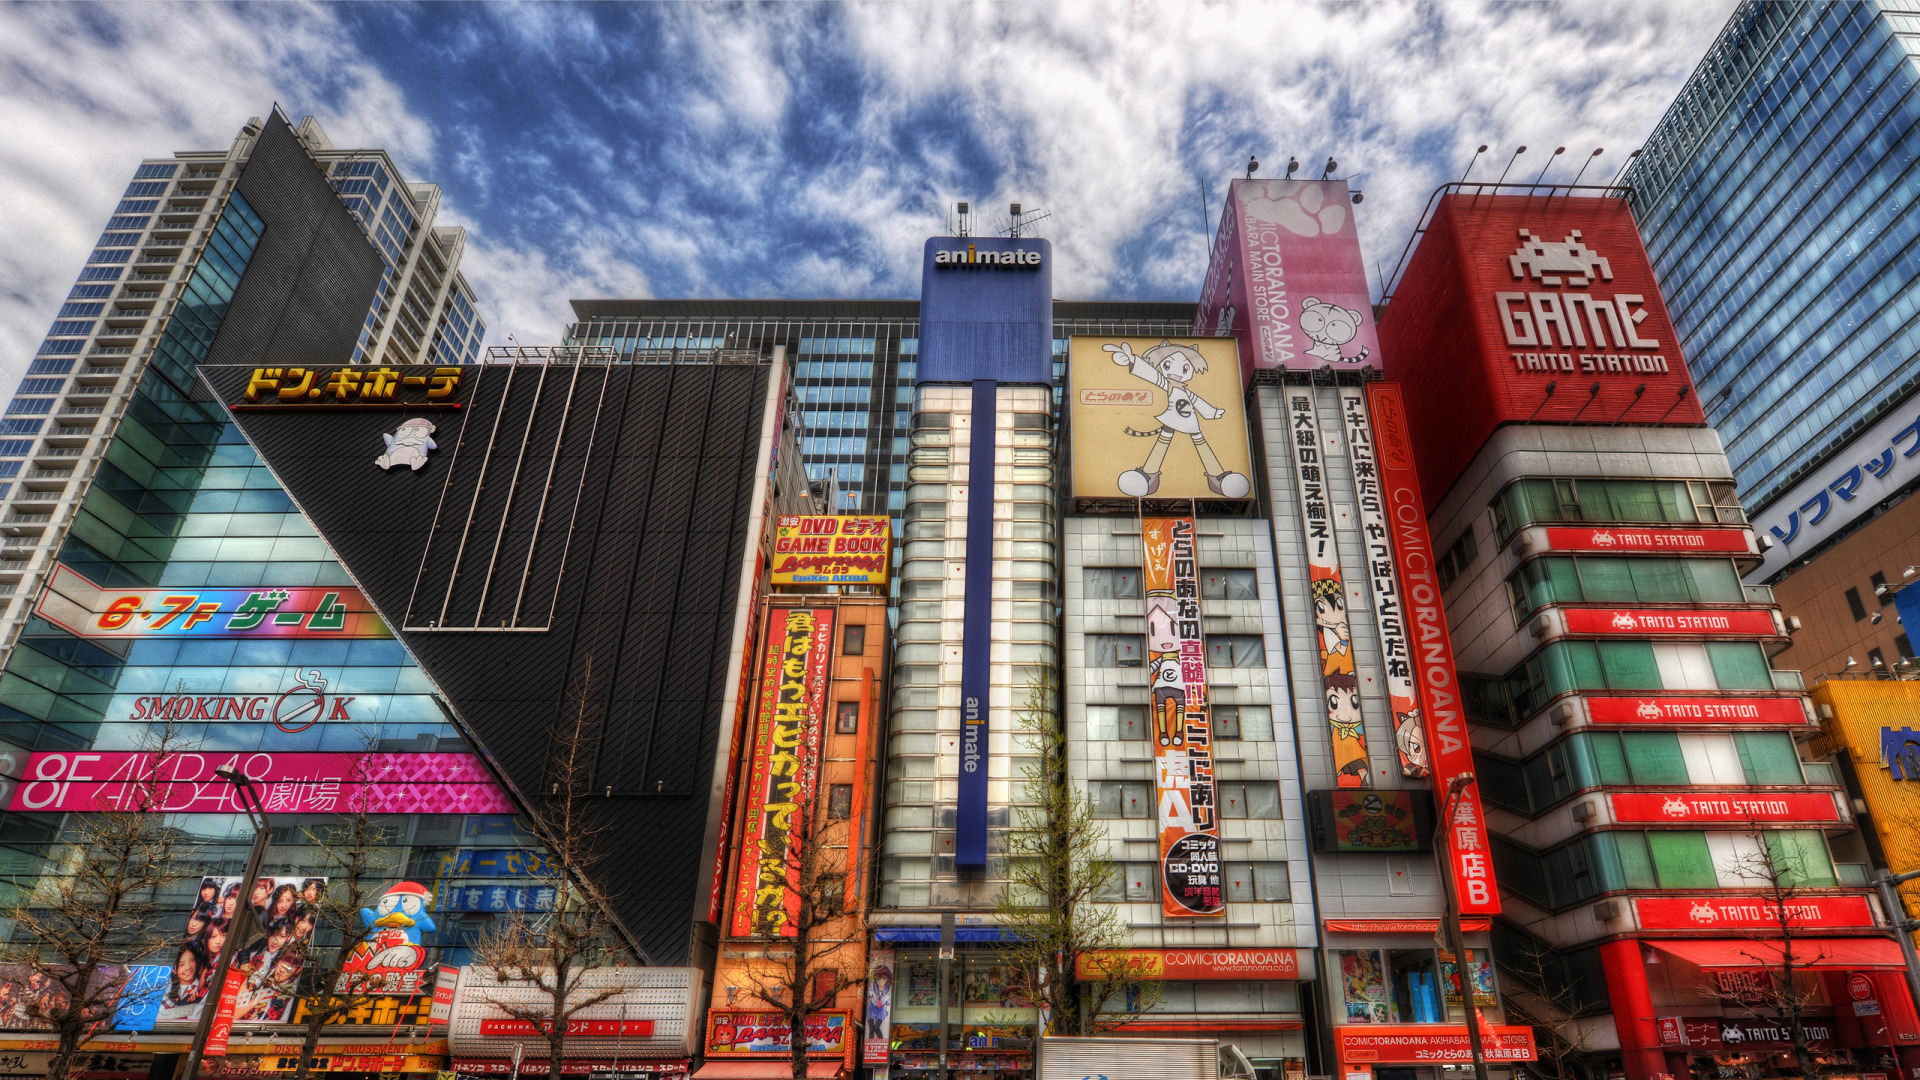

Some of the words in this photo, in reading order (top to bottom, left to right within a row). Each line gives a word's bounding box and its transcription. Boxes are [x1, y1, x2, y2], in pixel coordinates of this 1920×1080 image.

[935, 244, 1042, 265] animate
[1250, 251, 1265, 282] MAIN
[1259, 221, 1296, 363] ICTORANOANA
[1254, 285, 1270, 321] STORE
[1495, 291, 1661, 350] GAME
[1511, 352, 1575, 373] TAITO
[1578, 353, 1670, 375] STATION
[1084, 391, 1148, 402] とらのあな
[798, 517, 839, 536] DVD
[841, 517, 888, 536] ビデオ
[776, 537, 831, 554] GAME
[834, 537, 887, 554] BOOK
[1616, 534, 1653, 546] TAITO
[1654, 534, 1705, 546] STATION
[831, 574, 869, 582] AKIBA
[225, 589, 346, 630] ゲーム
[1638, 615, 1675, 628] TAITO
[1677, 616, 1730, 629] STATION
[129, 696, 268, 720] SMOKING
[1663, 704, 1702, 718] TAITO
[1706, 704, 1759, 718] STATION
[964, 697, 985, 773] animate
[22, 753, 102, 808] 8F
[1690, 800, 1731, 815] TAITO
[1733, 800, 1789, 815] STATION
[1181, 839, 1217, 850] コミック
[1718, 905, 1759, 920] TAITO
[1763, 904, 1822, 920] STATION
[1351, 922, 1438, 932] http://www.toranoana
[1164, 952, 1295, 966] COMICTORANOANA
[1212, 964, 1296, 973] www.toranoana.co.jp/
[804, 1015, 828, 1027] AME
[1344, 1037, 1428, 1046] COMICTORANOANA
[1429, 1036, 1471, 1046] AKIHABAR
[1503, 1035, 1528, 1045] STORE
[1745, 1027, 1780, 1041] TAITO
[1781, 1026, 1830, 1041] STION
[275, 1044, 328, 1054] DISCNT
[342, 1044, 408, 1054] AMUSEMENT
[1415, 1049, 1473, 1060] コミックとらのあ
[1485, 1047, 1530, 1059] 秋葉原店B
[220, 1066, 249, 1077] Crazy
